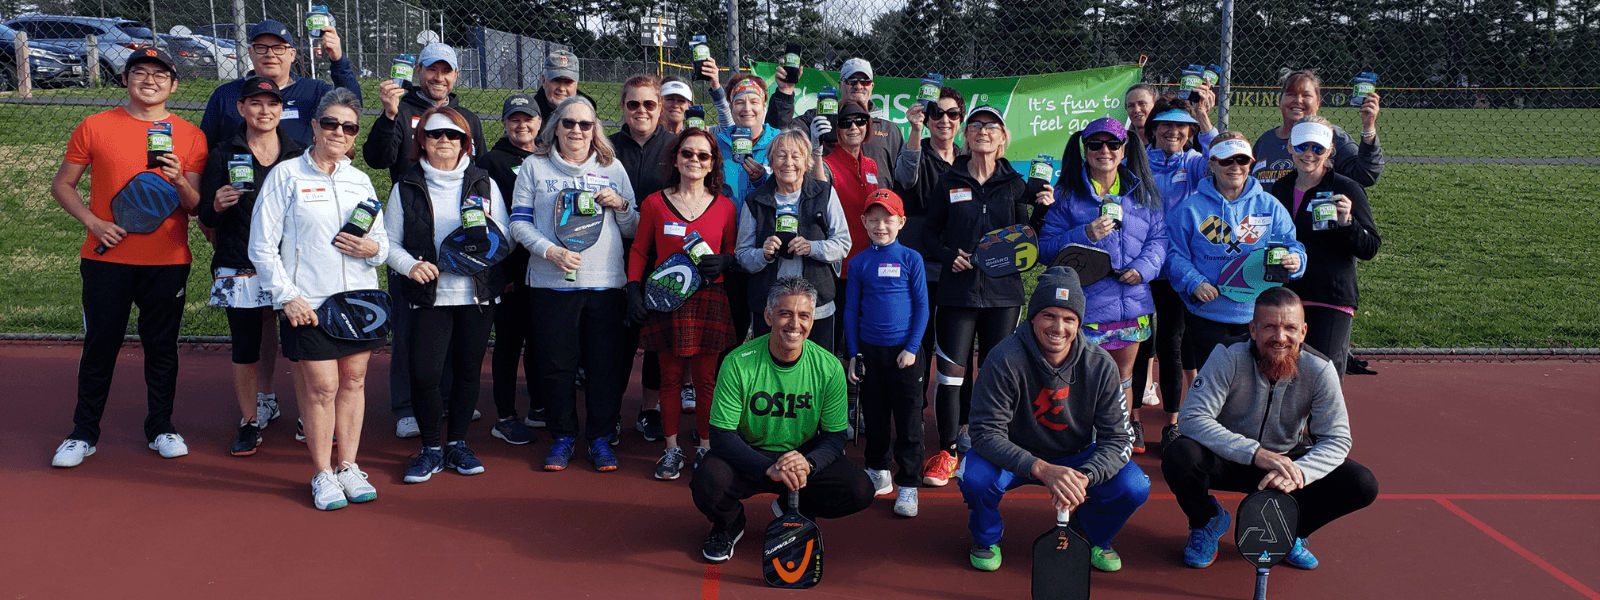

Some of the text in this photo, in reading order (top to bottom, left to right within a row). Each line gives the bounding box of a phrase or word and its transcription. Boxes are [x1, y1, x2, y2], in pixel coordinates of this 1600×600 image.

[1028, 95, 1120, 114] It's fun to
[1030, 115, 1063, 136] feel
[750, 391, 813, 419] OS1st
